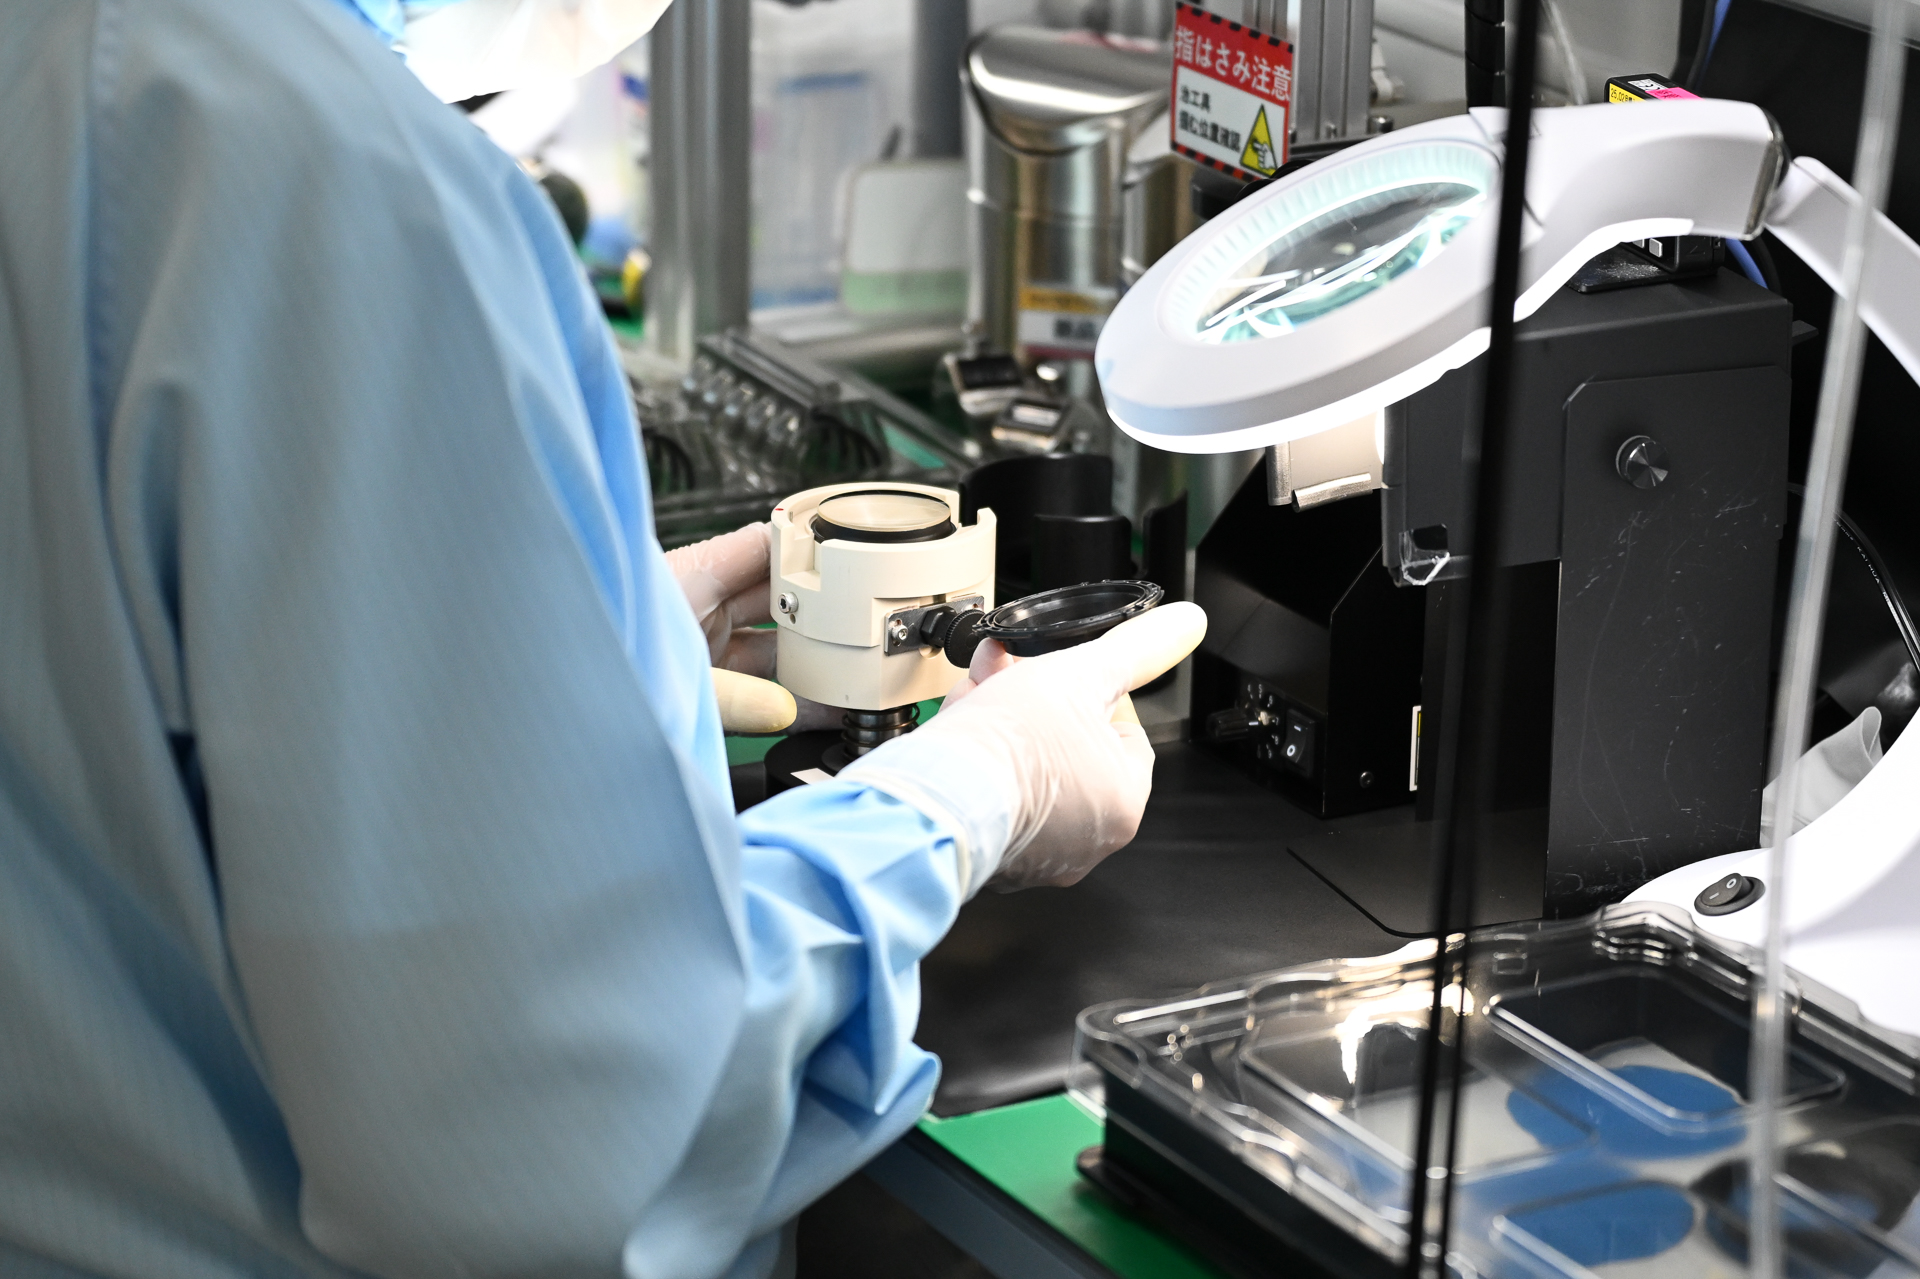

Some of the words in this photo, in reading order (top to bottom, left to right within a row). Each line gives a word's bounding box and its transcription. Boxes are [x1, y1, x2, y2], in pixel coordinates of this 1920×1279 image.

[1175, 25, 1291, 101] 指はさみ注意
